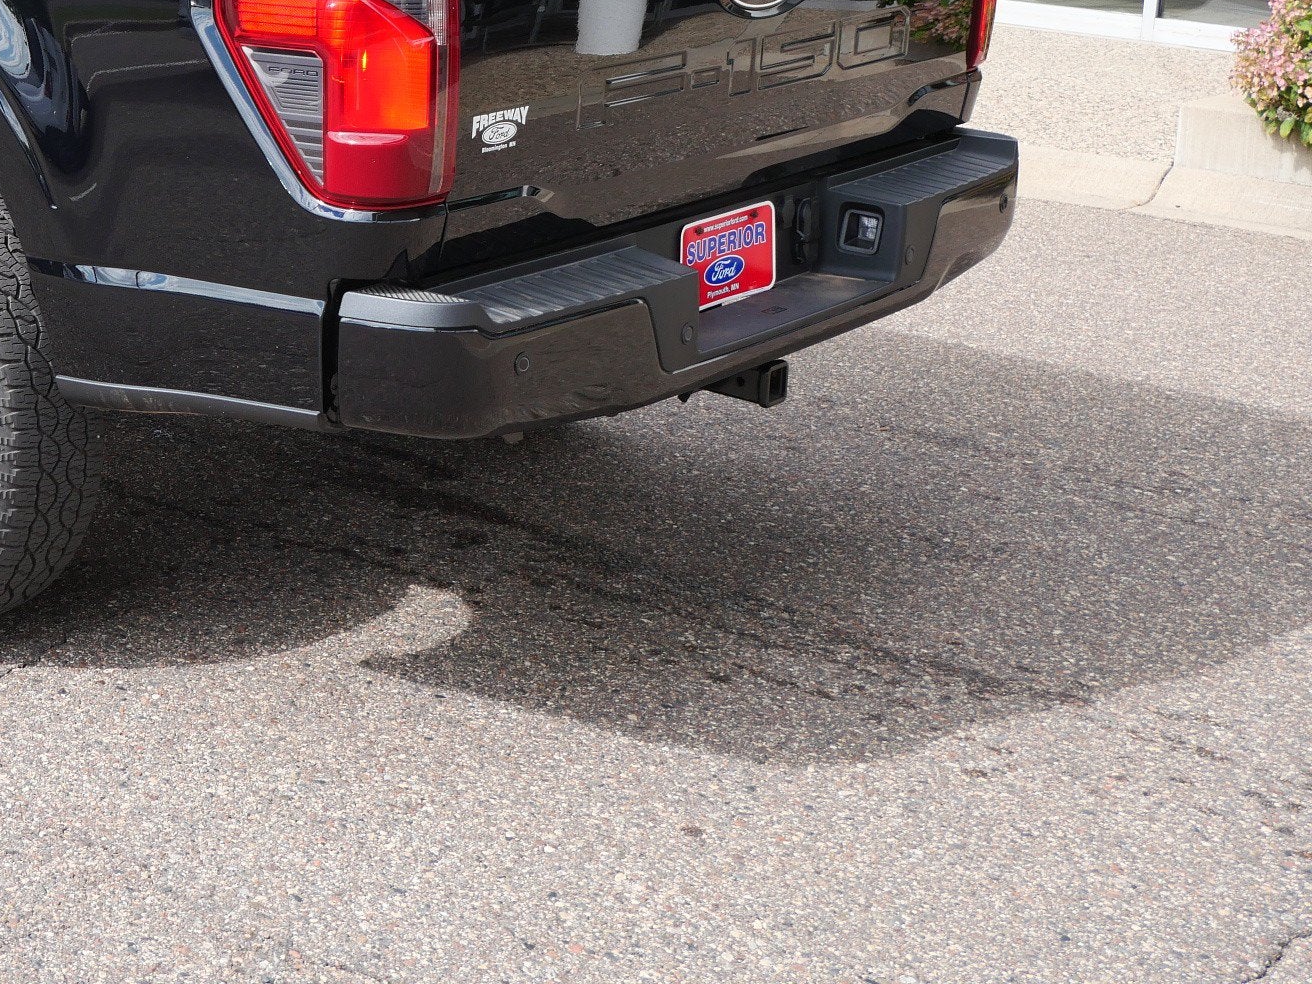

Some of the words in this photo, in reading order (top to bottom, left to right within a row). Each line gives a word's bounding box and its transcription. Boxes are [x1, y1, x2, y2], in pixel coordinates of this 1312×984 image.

[268, 66, 319, 77] FORD
[576, 4, 911, 131] F-150
[471, 106, 530, 140] FREEWAY
[686, 221, 767, 267] SUPERIOR
[711, 259, 737, 282] Ford
[731, 282, 740, 292] MN
